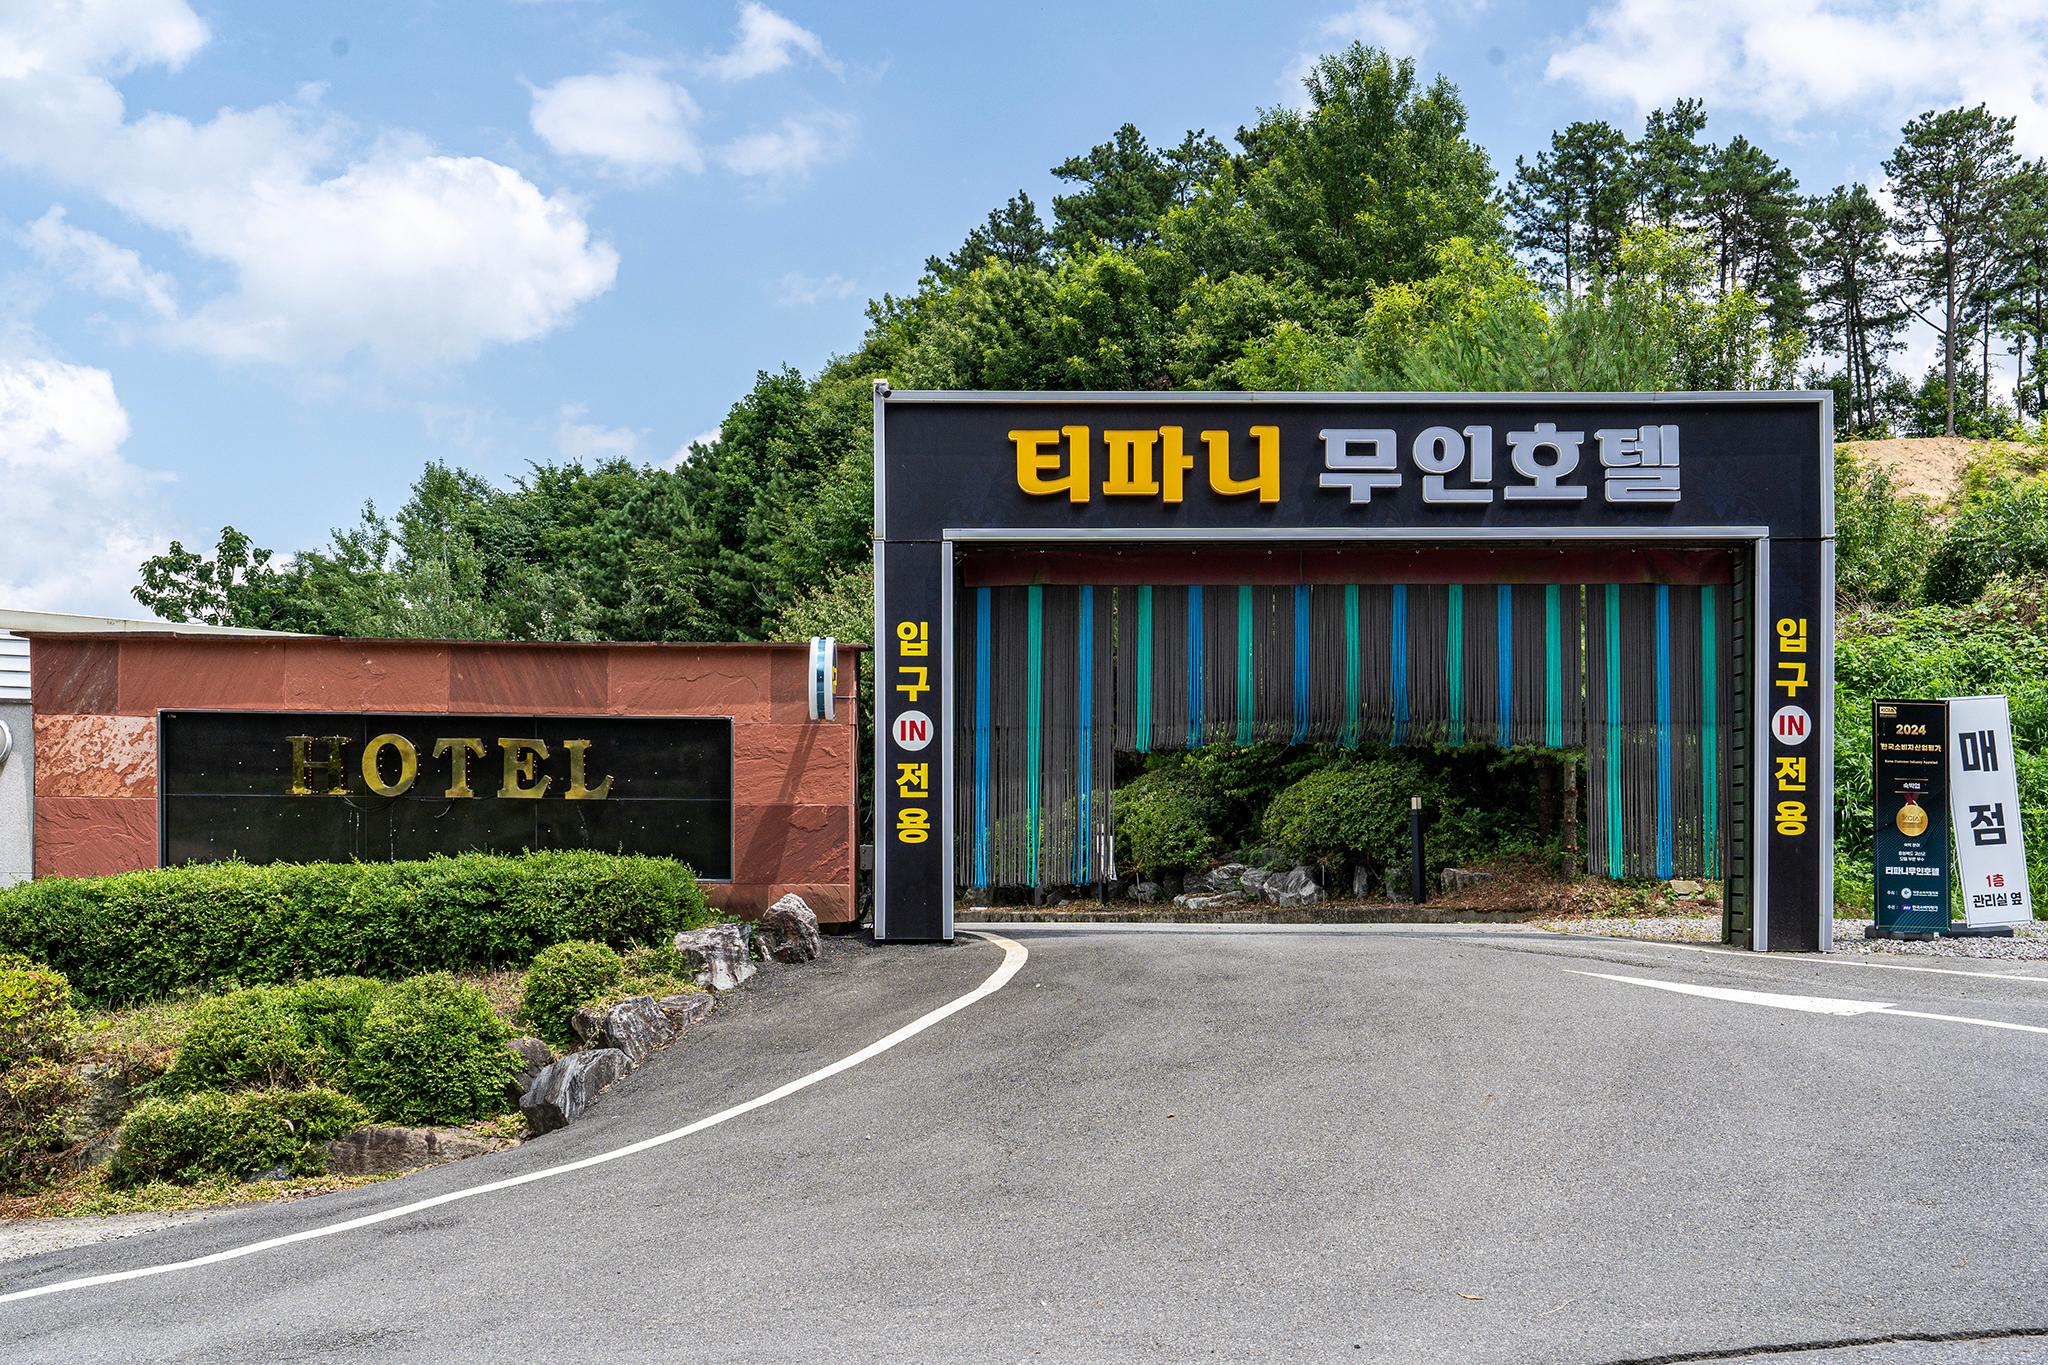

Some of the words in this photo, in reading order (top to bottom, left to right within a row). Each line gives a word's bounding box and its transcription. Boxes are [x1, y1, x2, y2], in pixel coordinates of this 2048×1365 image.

[1007, 425, 1281, 504] 티파니
[1318, 422, 1682, 505] 무인호텔
[895, 621, 931, 702] 입구
[1775, 618, 1809, 697] 입구
[900, 720, 926, 742] IN
[1779, 715, 1804, 736] IN
[1896, 724, 1927, 736] 2024
[285, 732, 613, 801] HOTEL
[1774, 757, 1808, 837] 전용
[895, 763, 931, 844] 전용
[1973, 893, 2008, 909] 관리실
[2010, 891, 2023, 906] 옆
[1985, 873, 2005, 888] 1층
